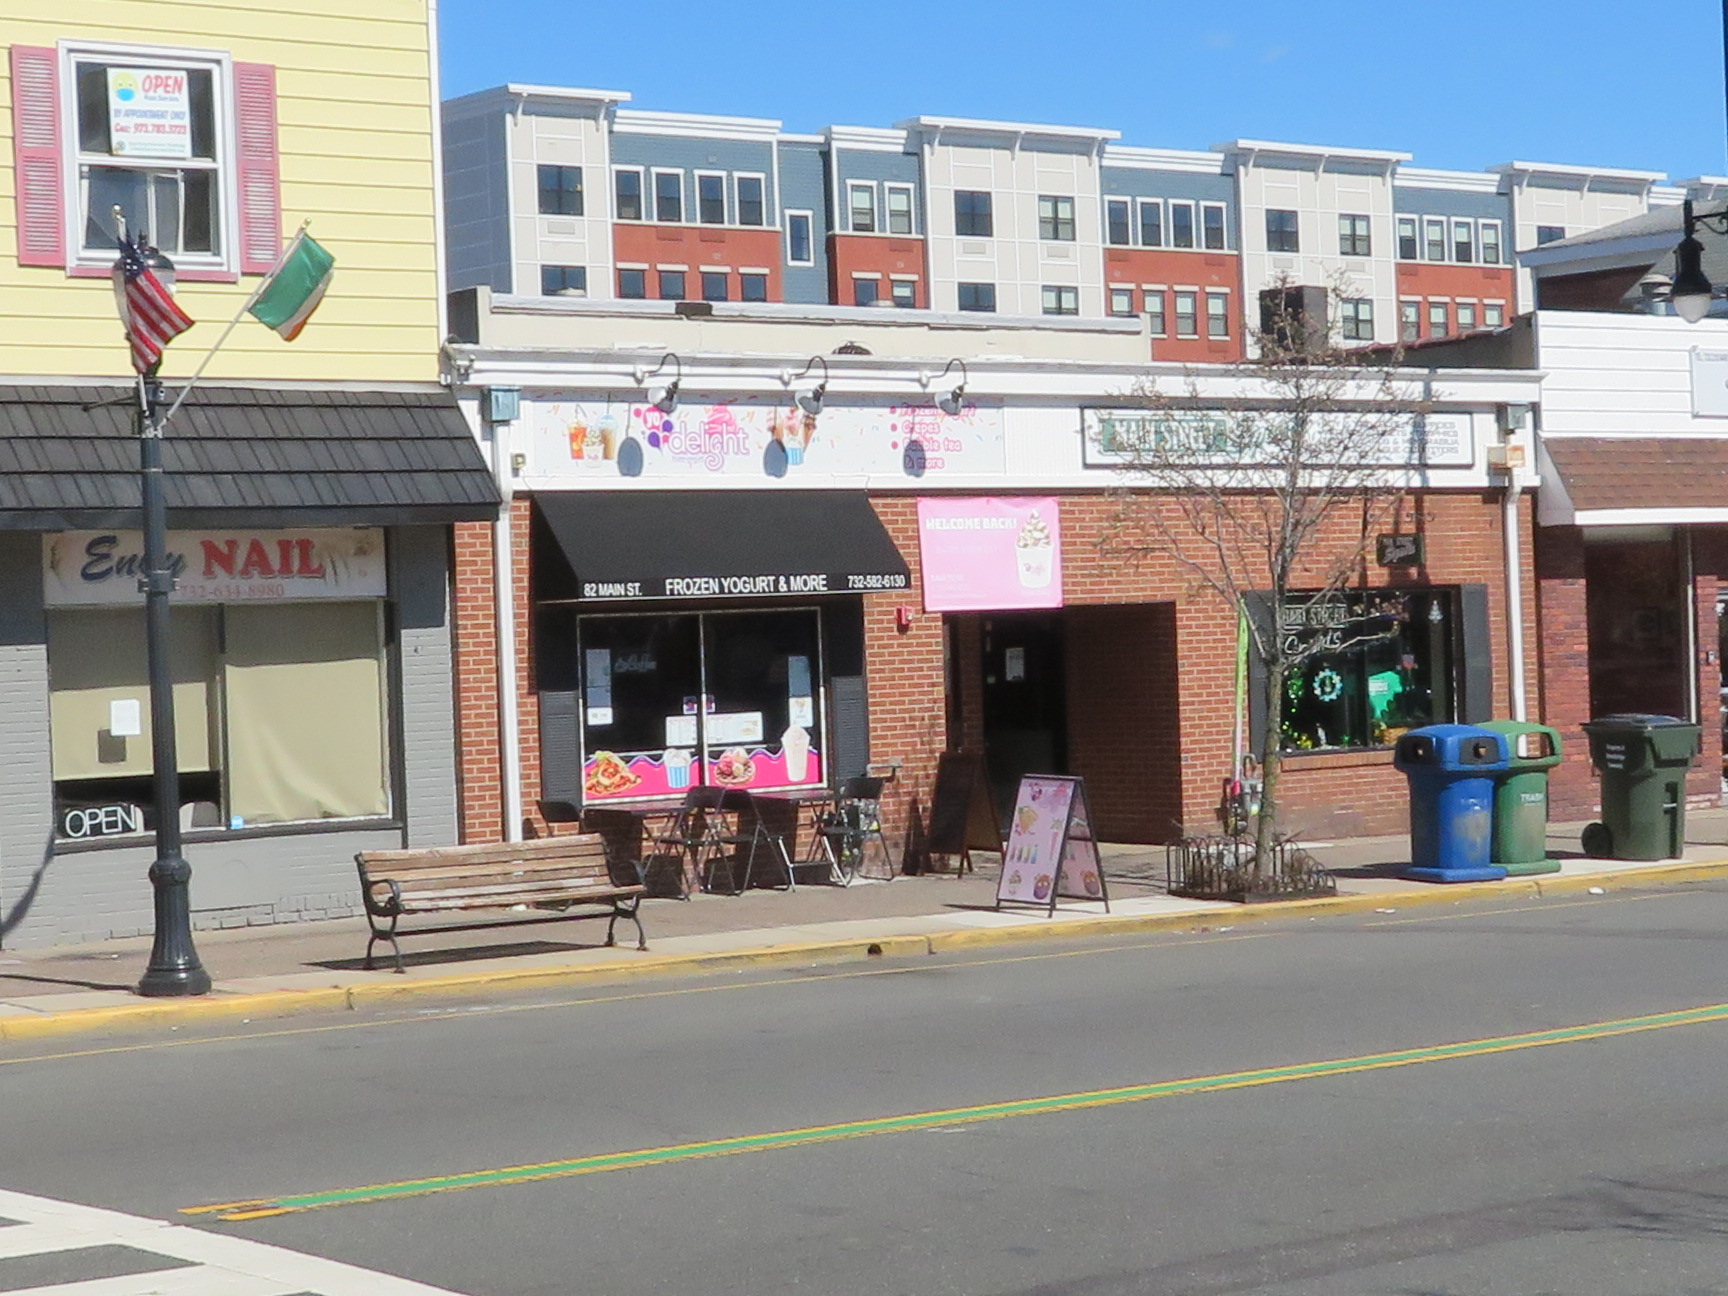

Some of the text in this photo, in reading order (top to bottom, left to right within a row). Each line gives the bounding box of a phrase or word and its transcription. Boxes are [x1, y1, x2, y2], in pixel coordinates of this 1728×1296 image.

[142, 74, 184, 94] OPEN
[901, 419, 940, 436] Crepes
[668, 422, 750, 471] delight
[943, 436, 963, 452] tea
[925, 517, 981, 530] WELCOME
[80, 534, 326, 582] Eny NAIL
[583, 575, 906, 597] 82 MAIN ST. FROZEN YOGURT & MORE 732-582-6130
[1519, 792, 1545, 803] TRASH
[65, 804, 136, 837] OPEN
